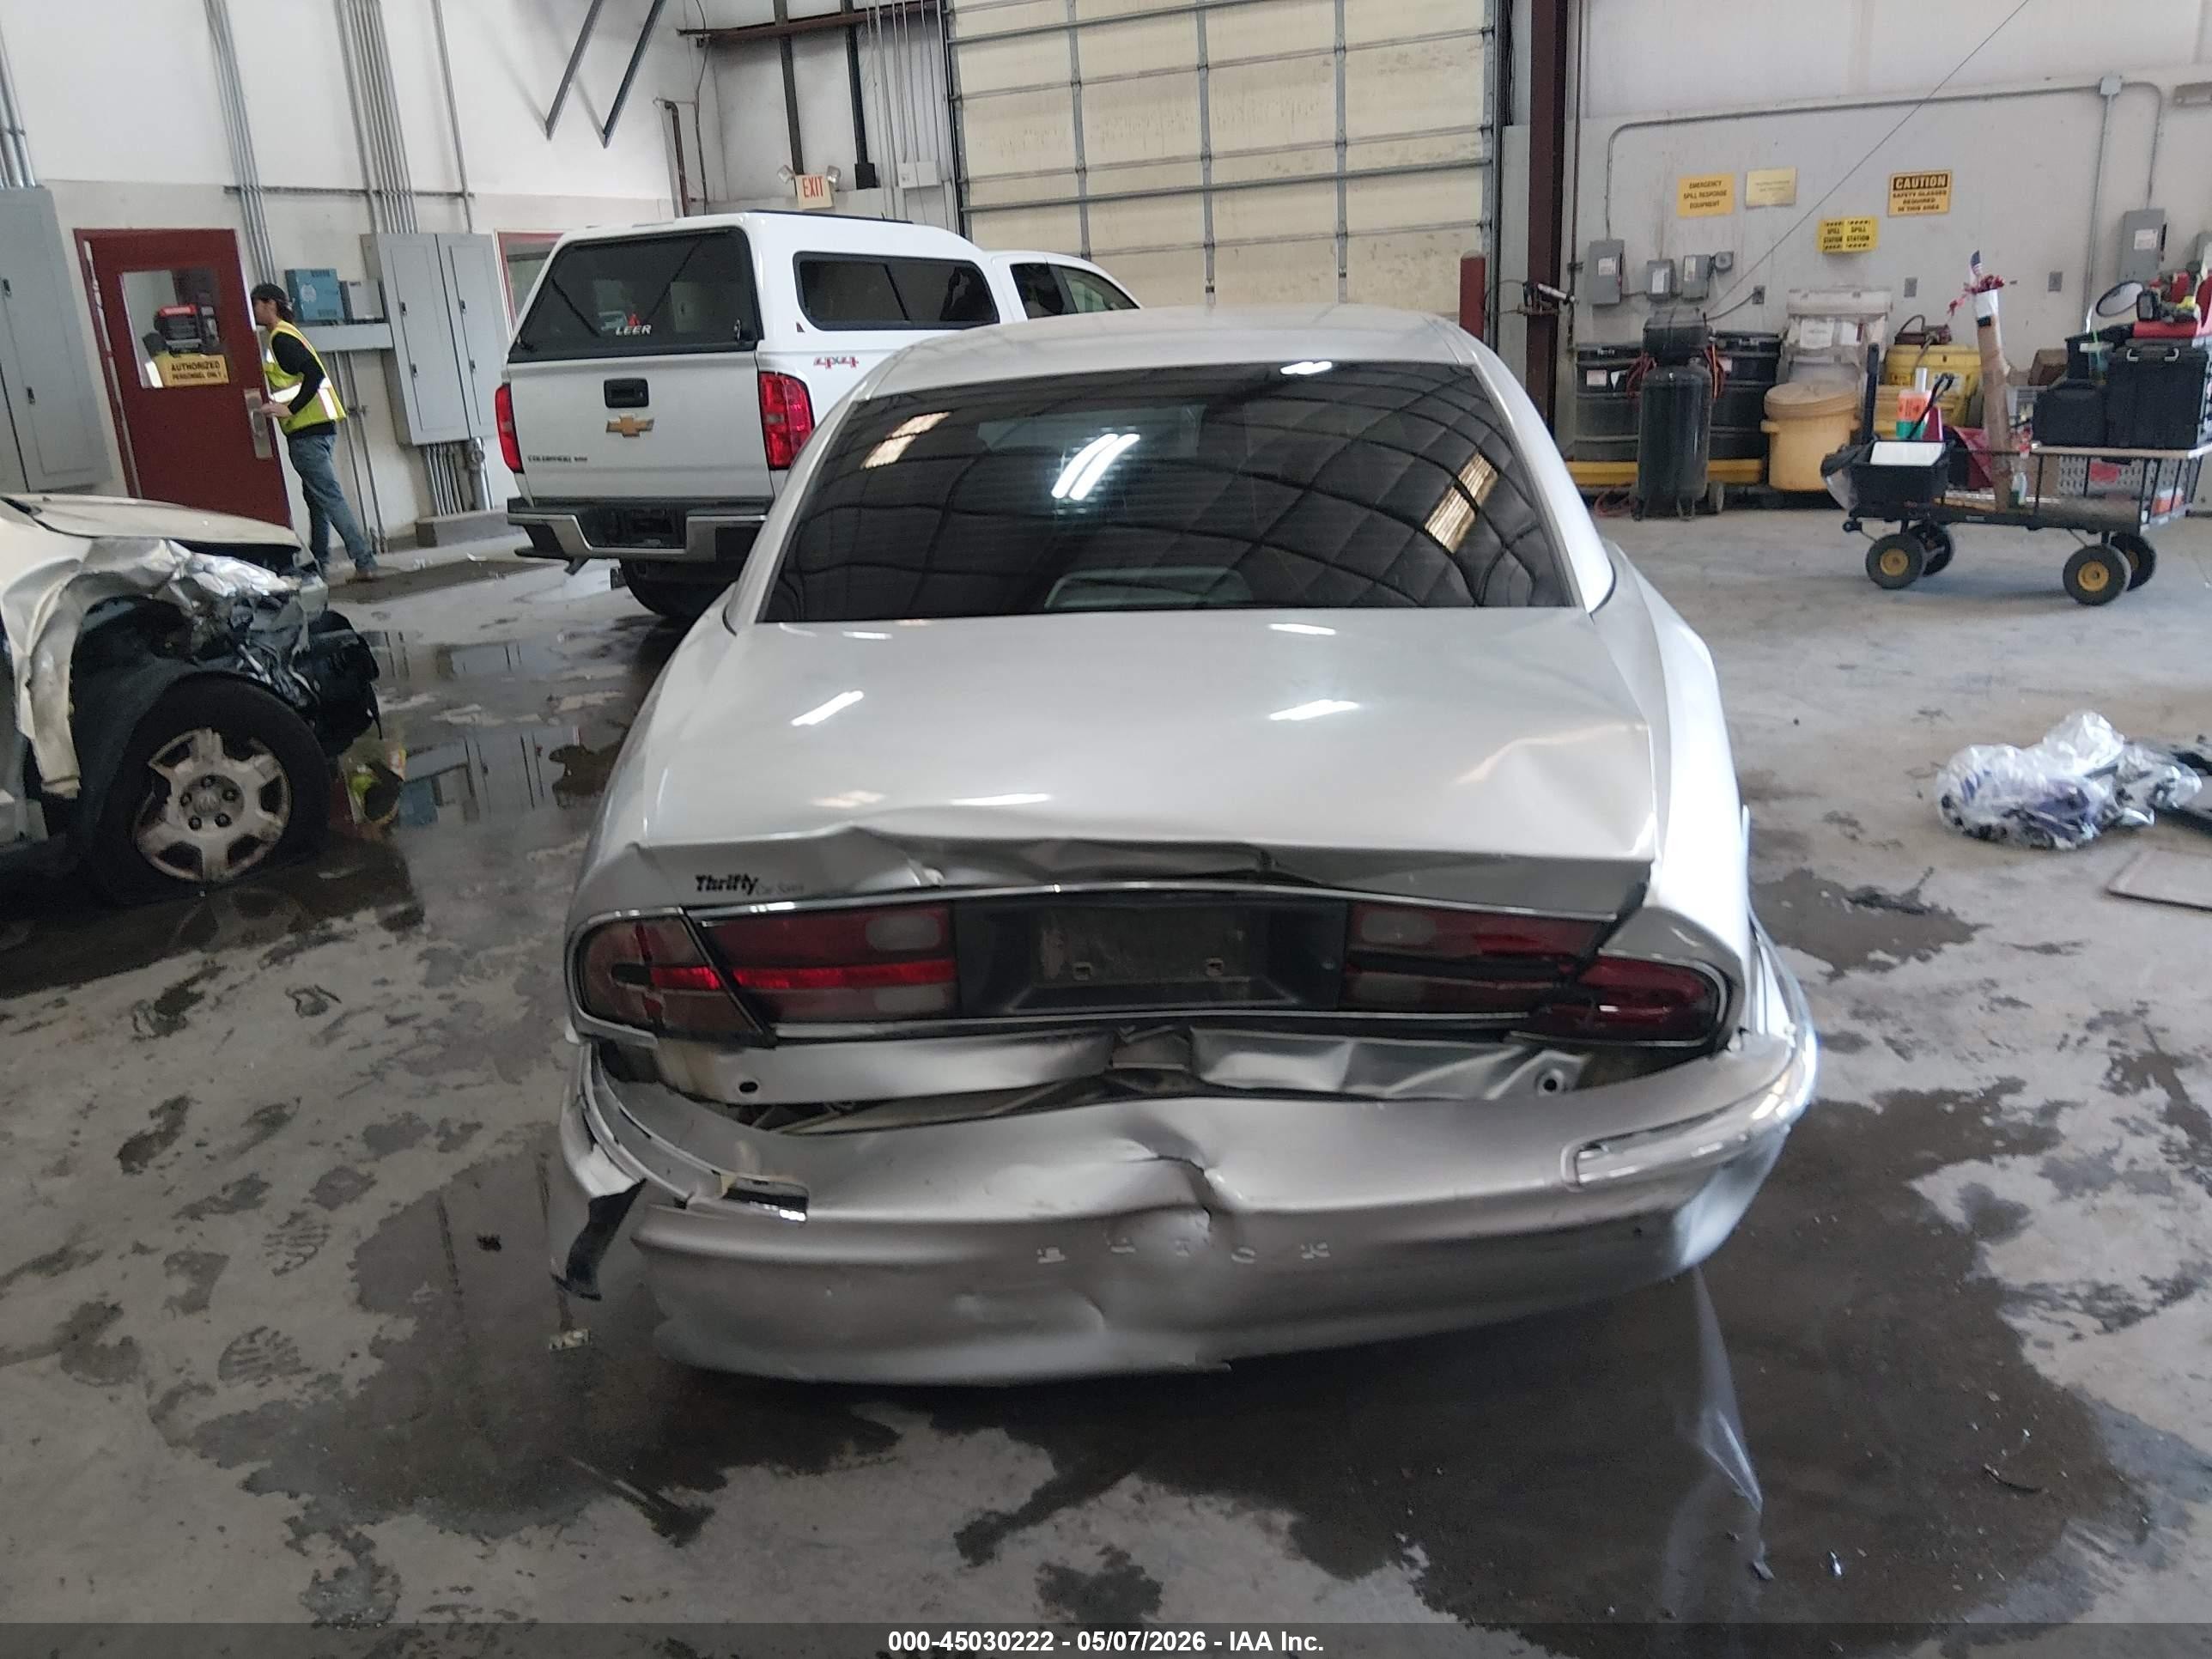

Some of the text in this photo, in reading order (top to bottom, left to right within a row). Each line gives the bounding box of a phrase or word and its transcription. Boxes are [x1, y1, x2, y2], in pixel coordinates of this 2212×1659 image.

[802, 176, 823, 198] EXIT
[1689, 180, 1722, 189] EMERGENCY
[1895, 175, 1947, 189] CAUTION
[1698, 190, 1727, 198] RESPONSE
[616, 325, 653, 336] LEER
[172, 361, 221, 371] AUTHORIZED
[695, 872, 759, 896] Thrifty
